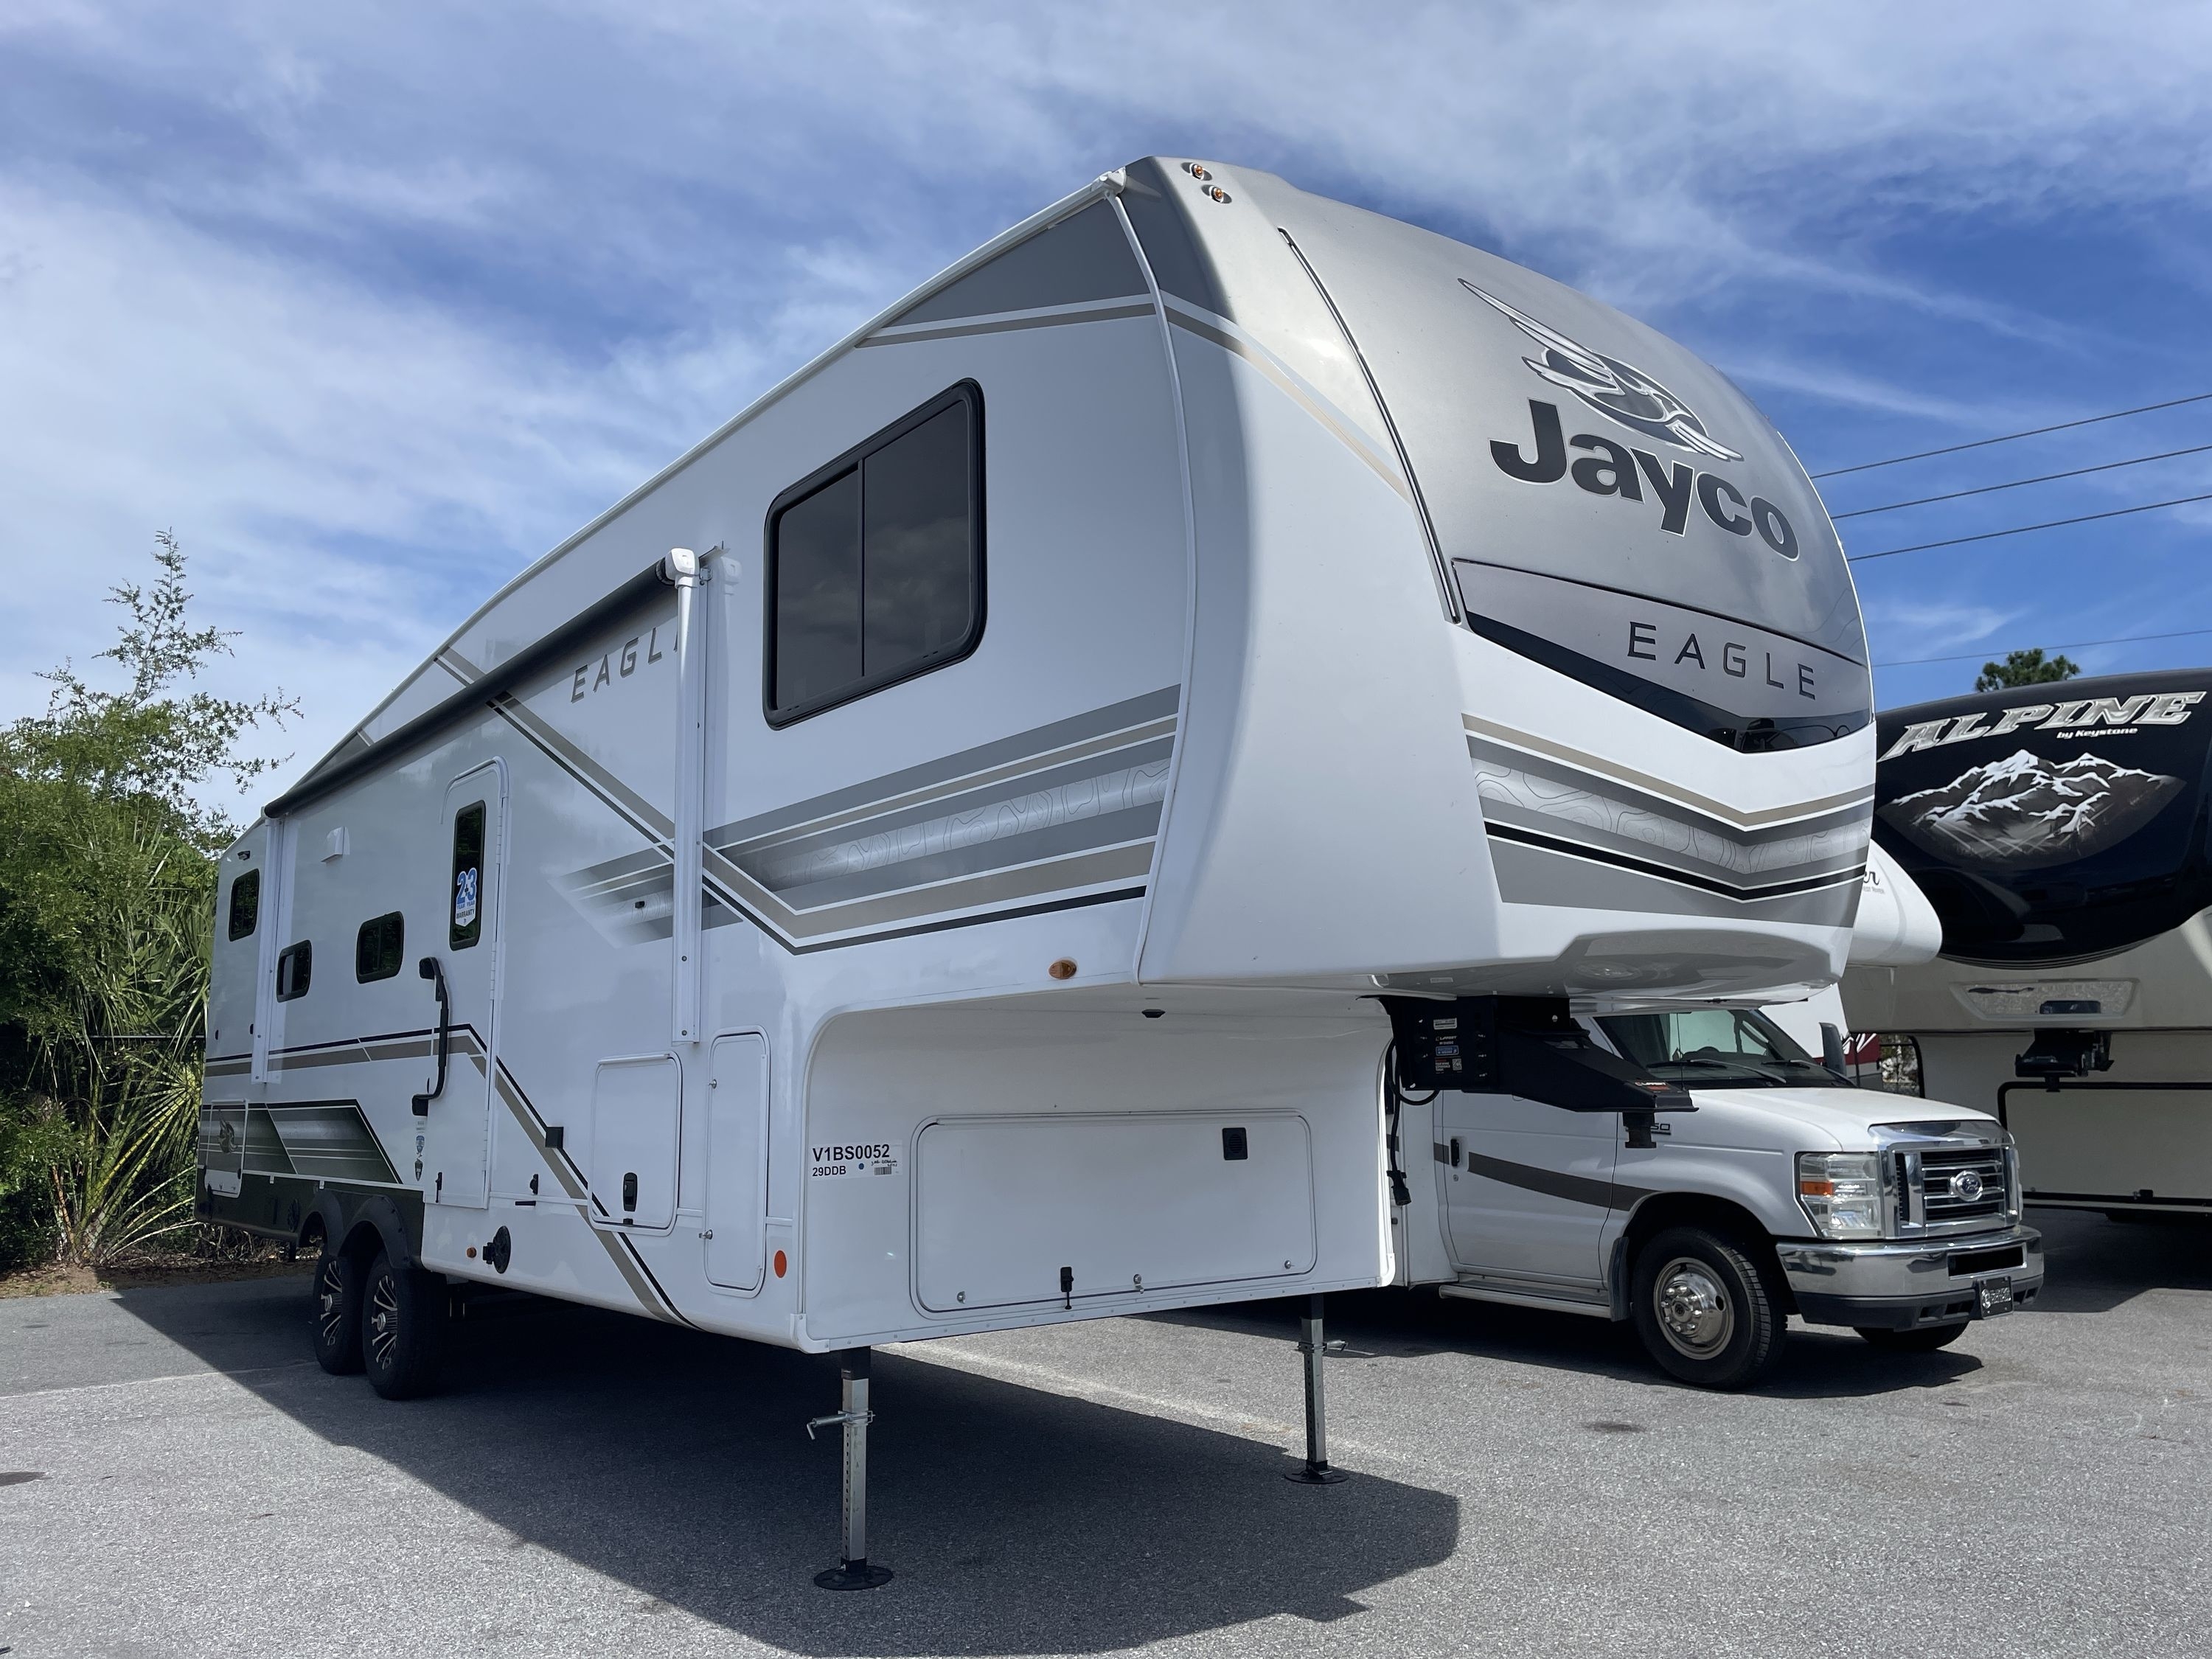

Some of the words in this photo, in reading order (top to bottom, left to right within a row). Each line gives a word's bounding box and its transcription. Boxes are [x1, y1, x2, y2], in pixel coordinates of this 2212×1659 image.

[1488, 398, 1801, 562] Jayco
[571, 627, 678, 703] EAGL
[1627, 621, 1816, 700] EAGLE
[1877, 691, 2208, 762] ALPINE
[2056, 731, 2074, 740] by
[2075, 728, 2138, 737] Keystone
[812, 1166, 846, 1177] 29DDB
[813, 1144, 890, 1162] V1BS0052
